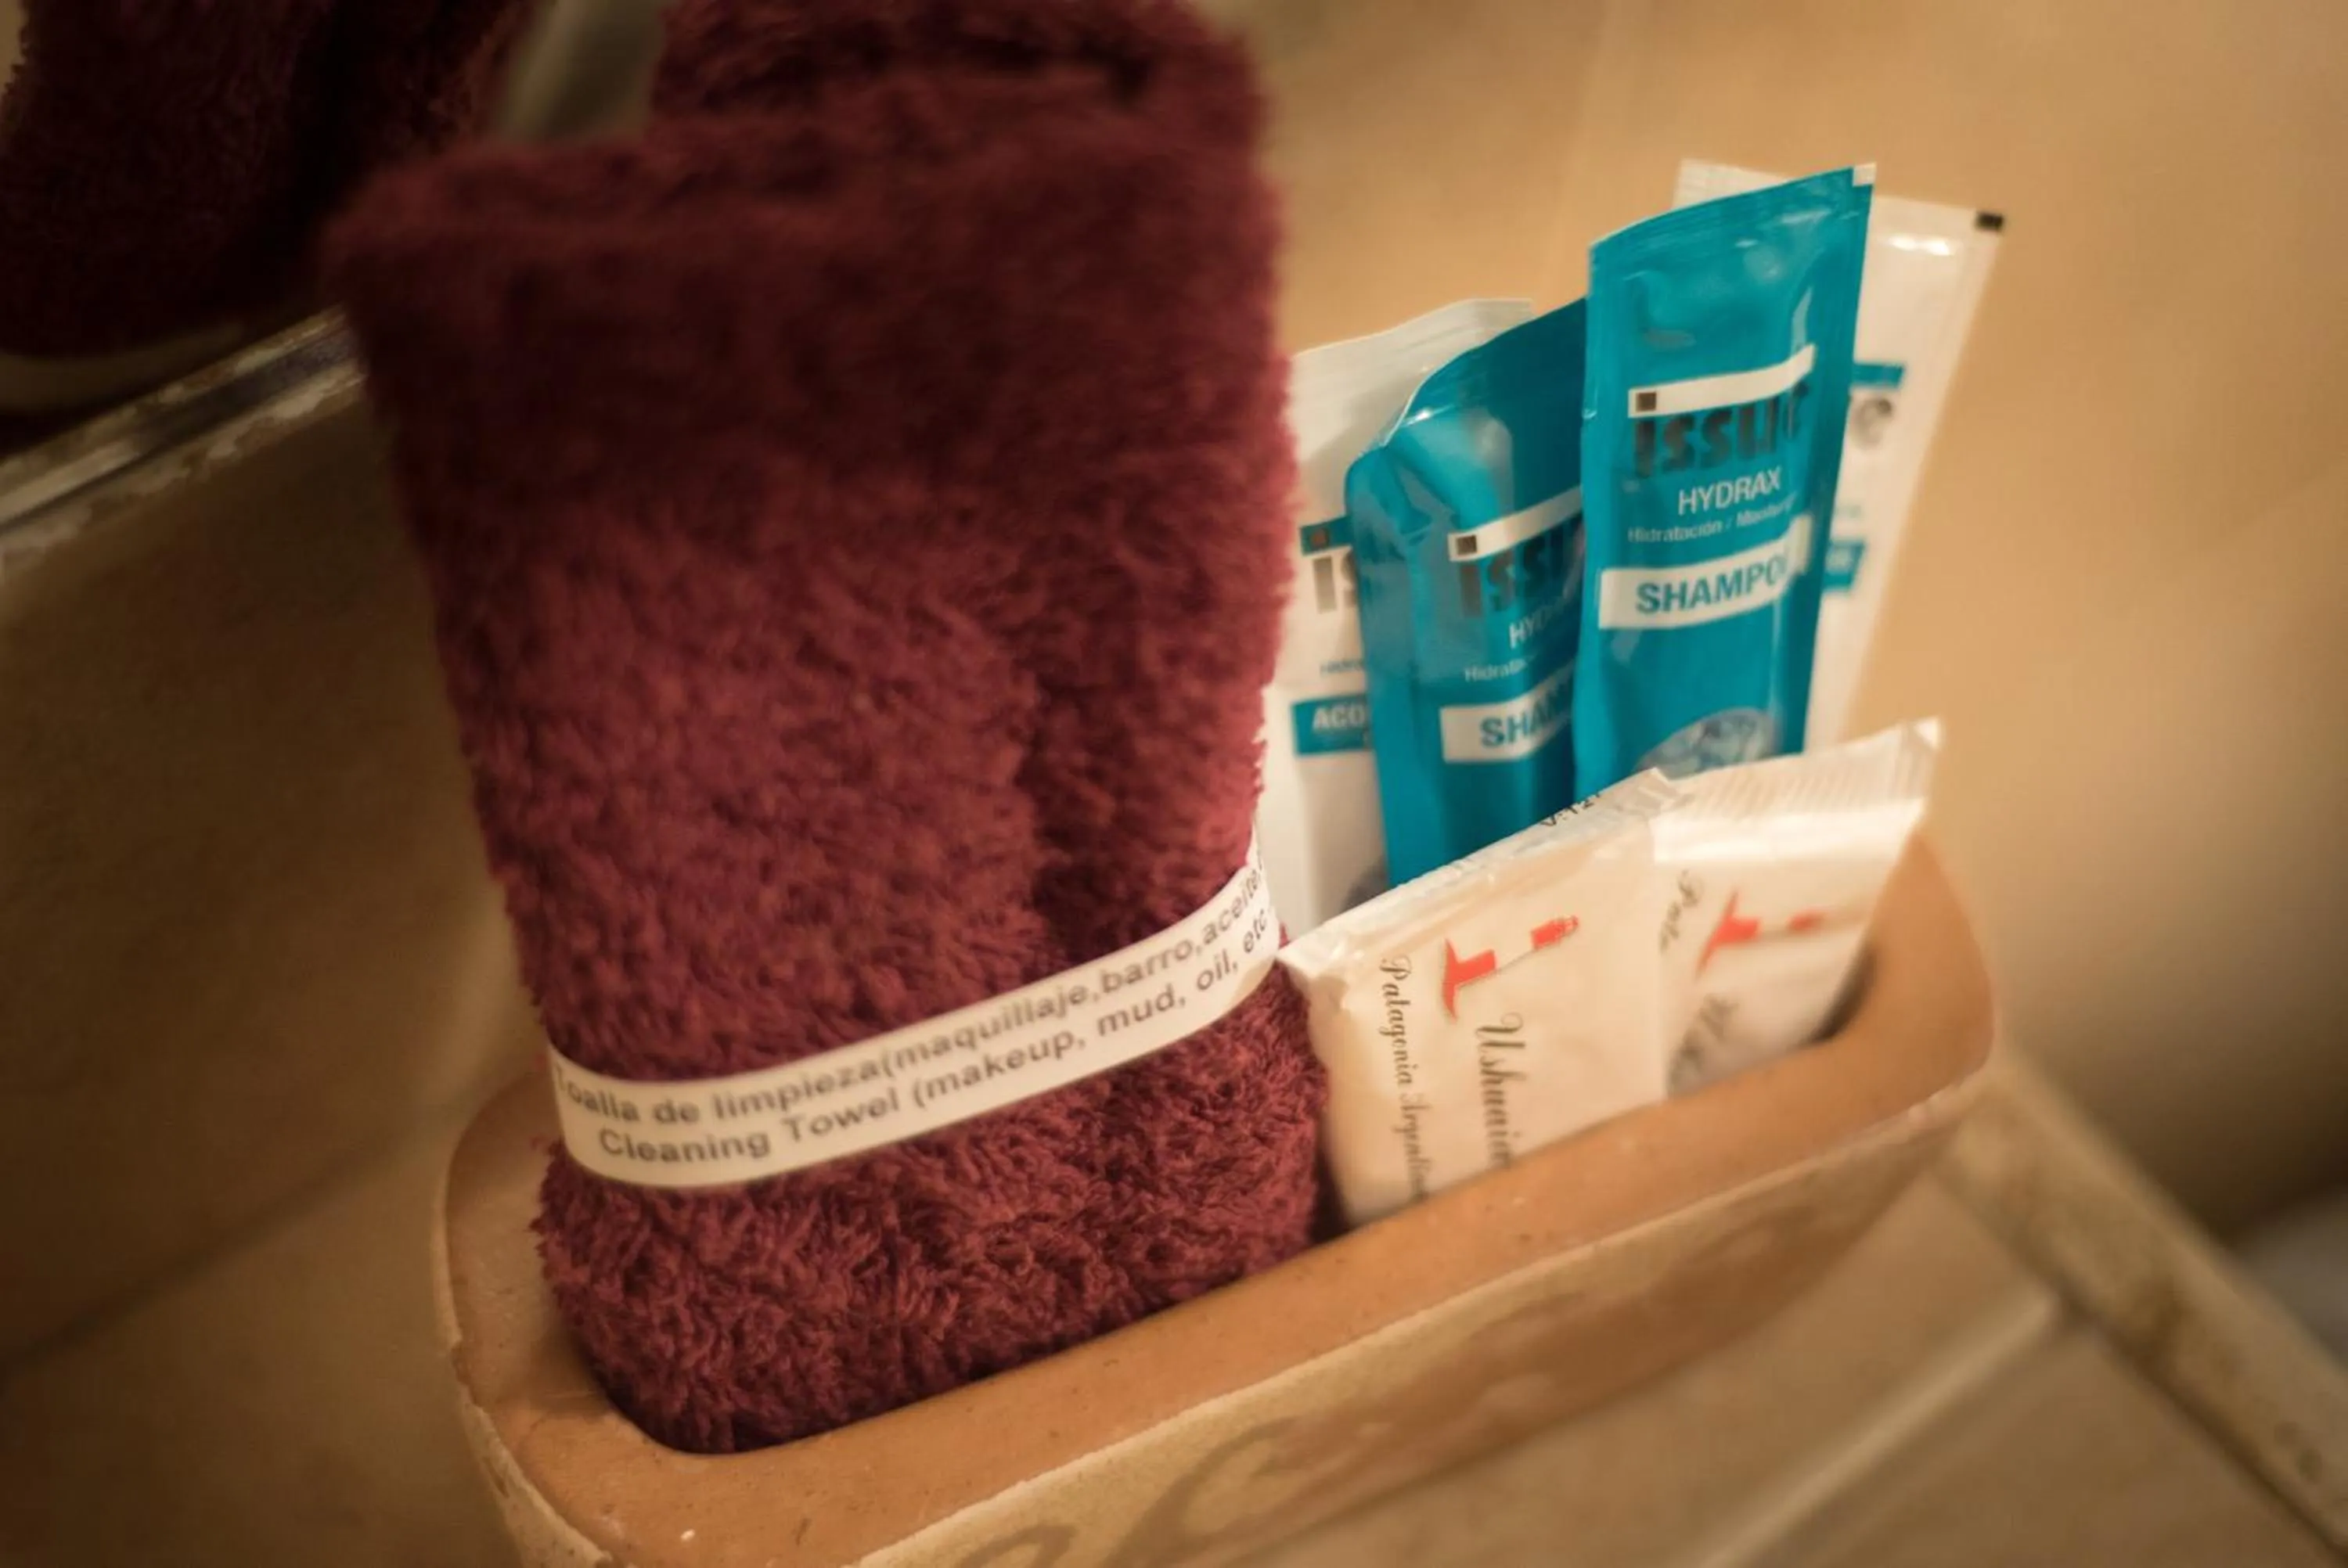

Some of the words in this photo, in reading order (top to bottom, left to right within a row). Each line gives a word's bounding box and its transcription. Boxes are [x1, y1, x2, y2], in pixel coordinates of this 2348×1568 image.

[1677, 466, 1781, 516] HYDRAX
[600, 1127, 770, 1163] Cleaning
[783, 1088, 900, 1143] Towel
[913, 1027, 1086, 1109] (makeup,
[1097, 987, 1186, 1038] mud,
[1195, 949, 1238, 993] oil,
[1378, 955, 1419, 1086] Patagonia
[653, 1098, 700, 1124] de
